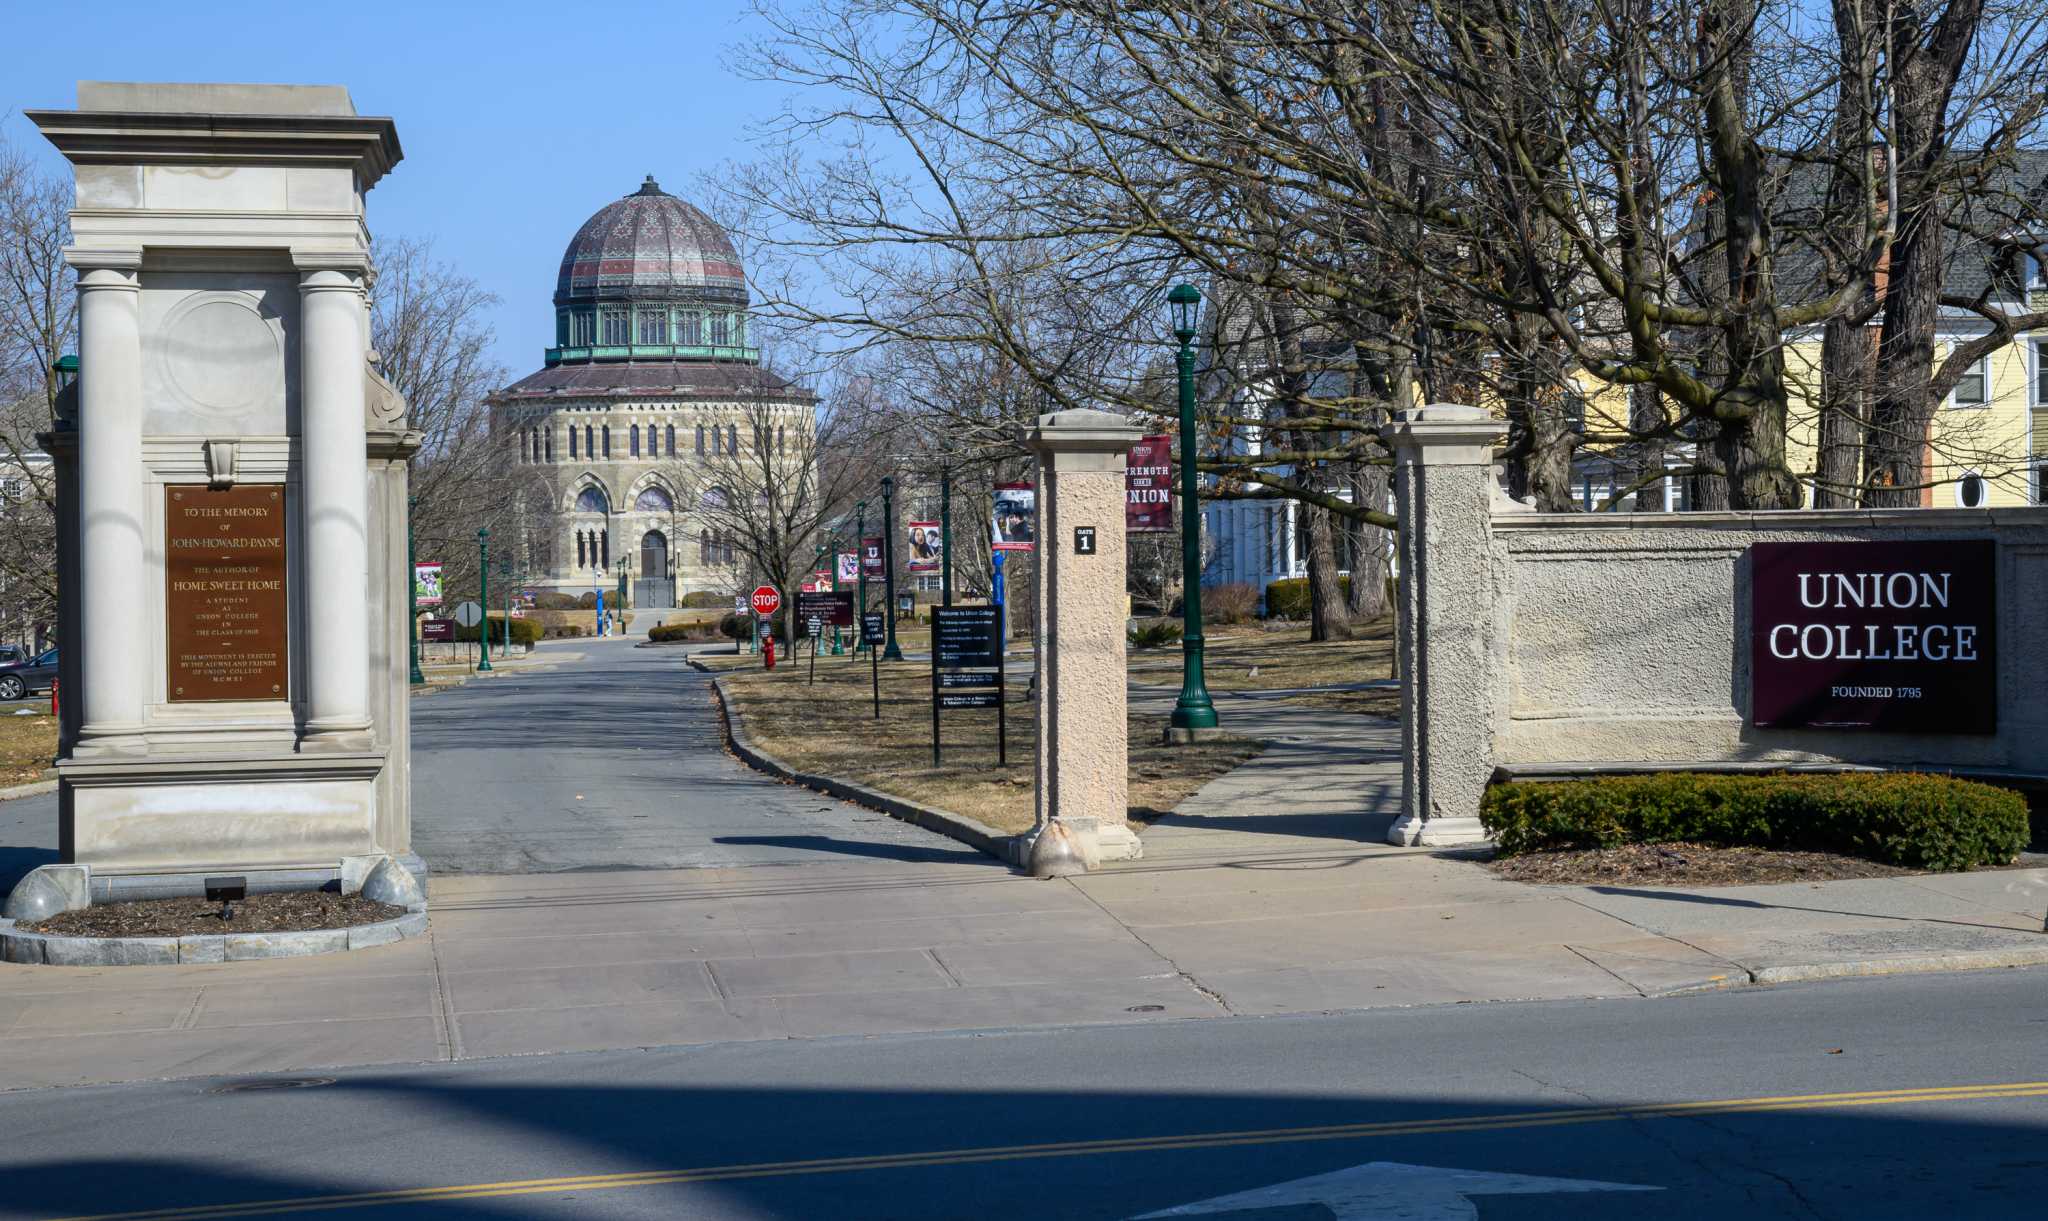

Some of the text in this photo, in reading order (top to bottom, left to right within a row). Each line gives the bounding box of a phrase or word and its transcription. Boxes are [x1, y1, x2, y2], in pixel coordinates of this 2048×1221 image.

[1125, 466, 1169, 476] TRENGTH
[1126, 489, 1170, 504] NION
[184, 508, 269, 517] TO THE MEMORY
[1080, 536, 1091, 550] 1
[193, 566, 260, 575] THE AUTHOR OF
[174, 580, 281, 592] HOME SWEET HOME
[1797, 572, 1951, 608] UNION
[214, 597, 249, 605] STUDENT
[753, 594, 778, 606] STOP
[224, 612, 259, 620] COLLEGE
[1769, 623, 1977, 660] COLLEGE
[198, 653, 237, 661] MONUMENT
[247, 653, 277, 661] ERECTED
[248, 660, 277, 668] FRIENDS
[203, 668, 227, 676] UNION
[1831, 686, 1922, 698] FOUNDED 1795
